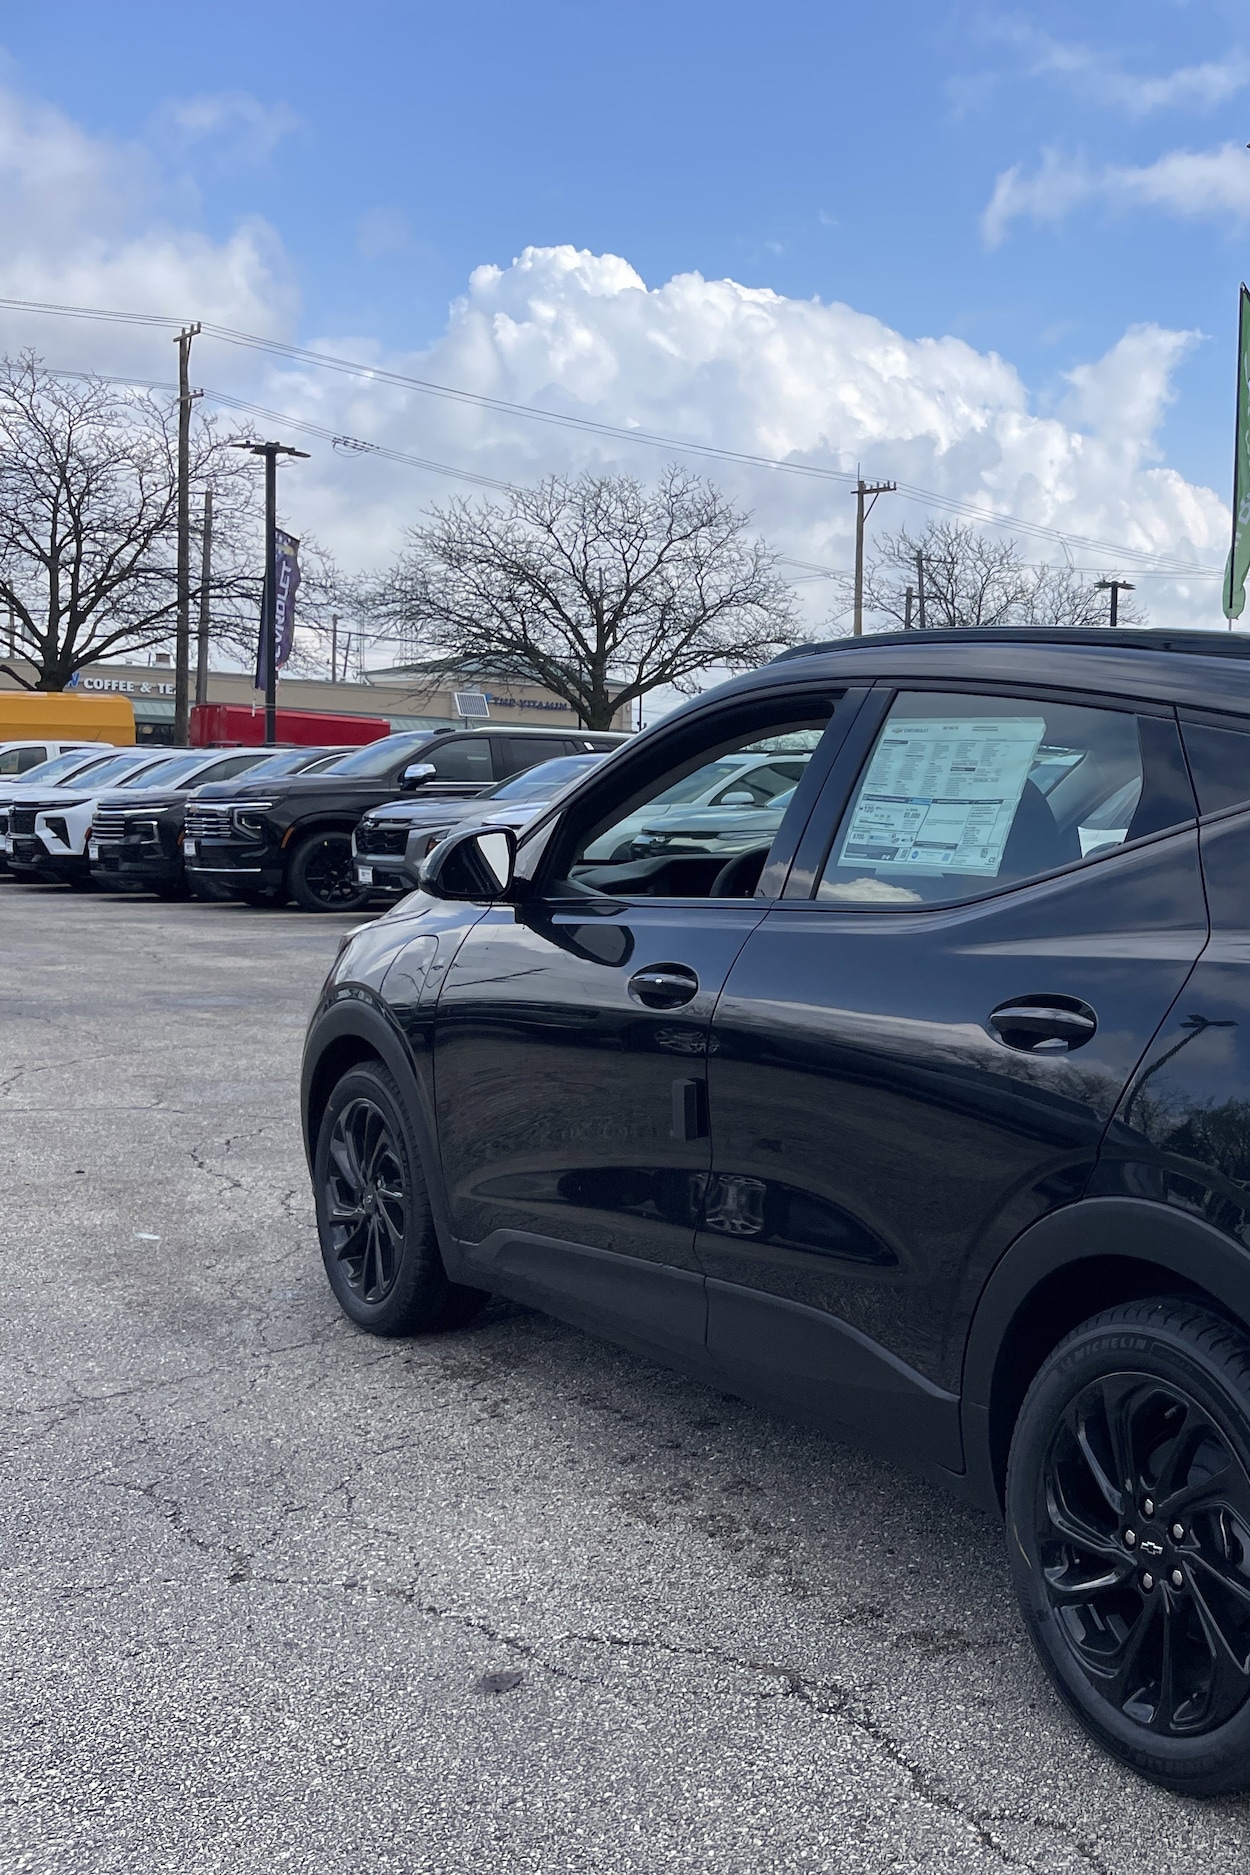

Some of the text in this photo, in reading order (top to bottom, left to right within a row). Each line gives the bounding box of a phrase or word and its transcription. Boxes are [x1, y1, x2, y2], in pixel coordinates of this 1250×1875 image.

[83, 677, 135, 692] COFFEE
[140, 682, 152, 693] &
[157, 682, 177, 695] TE
